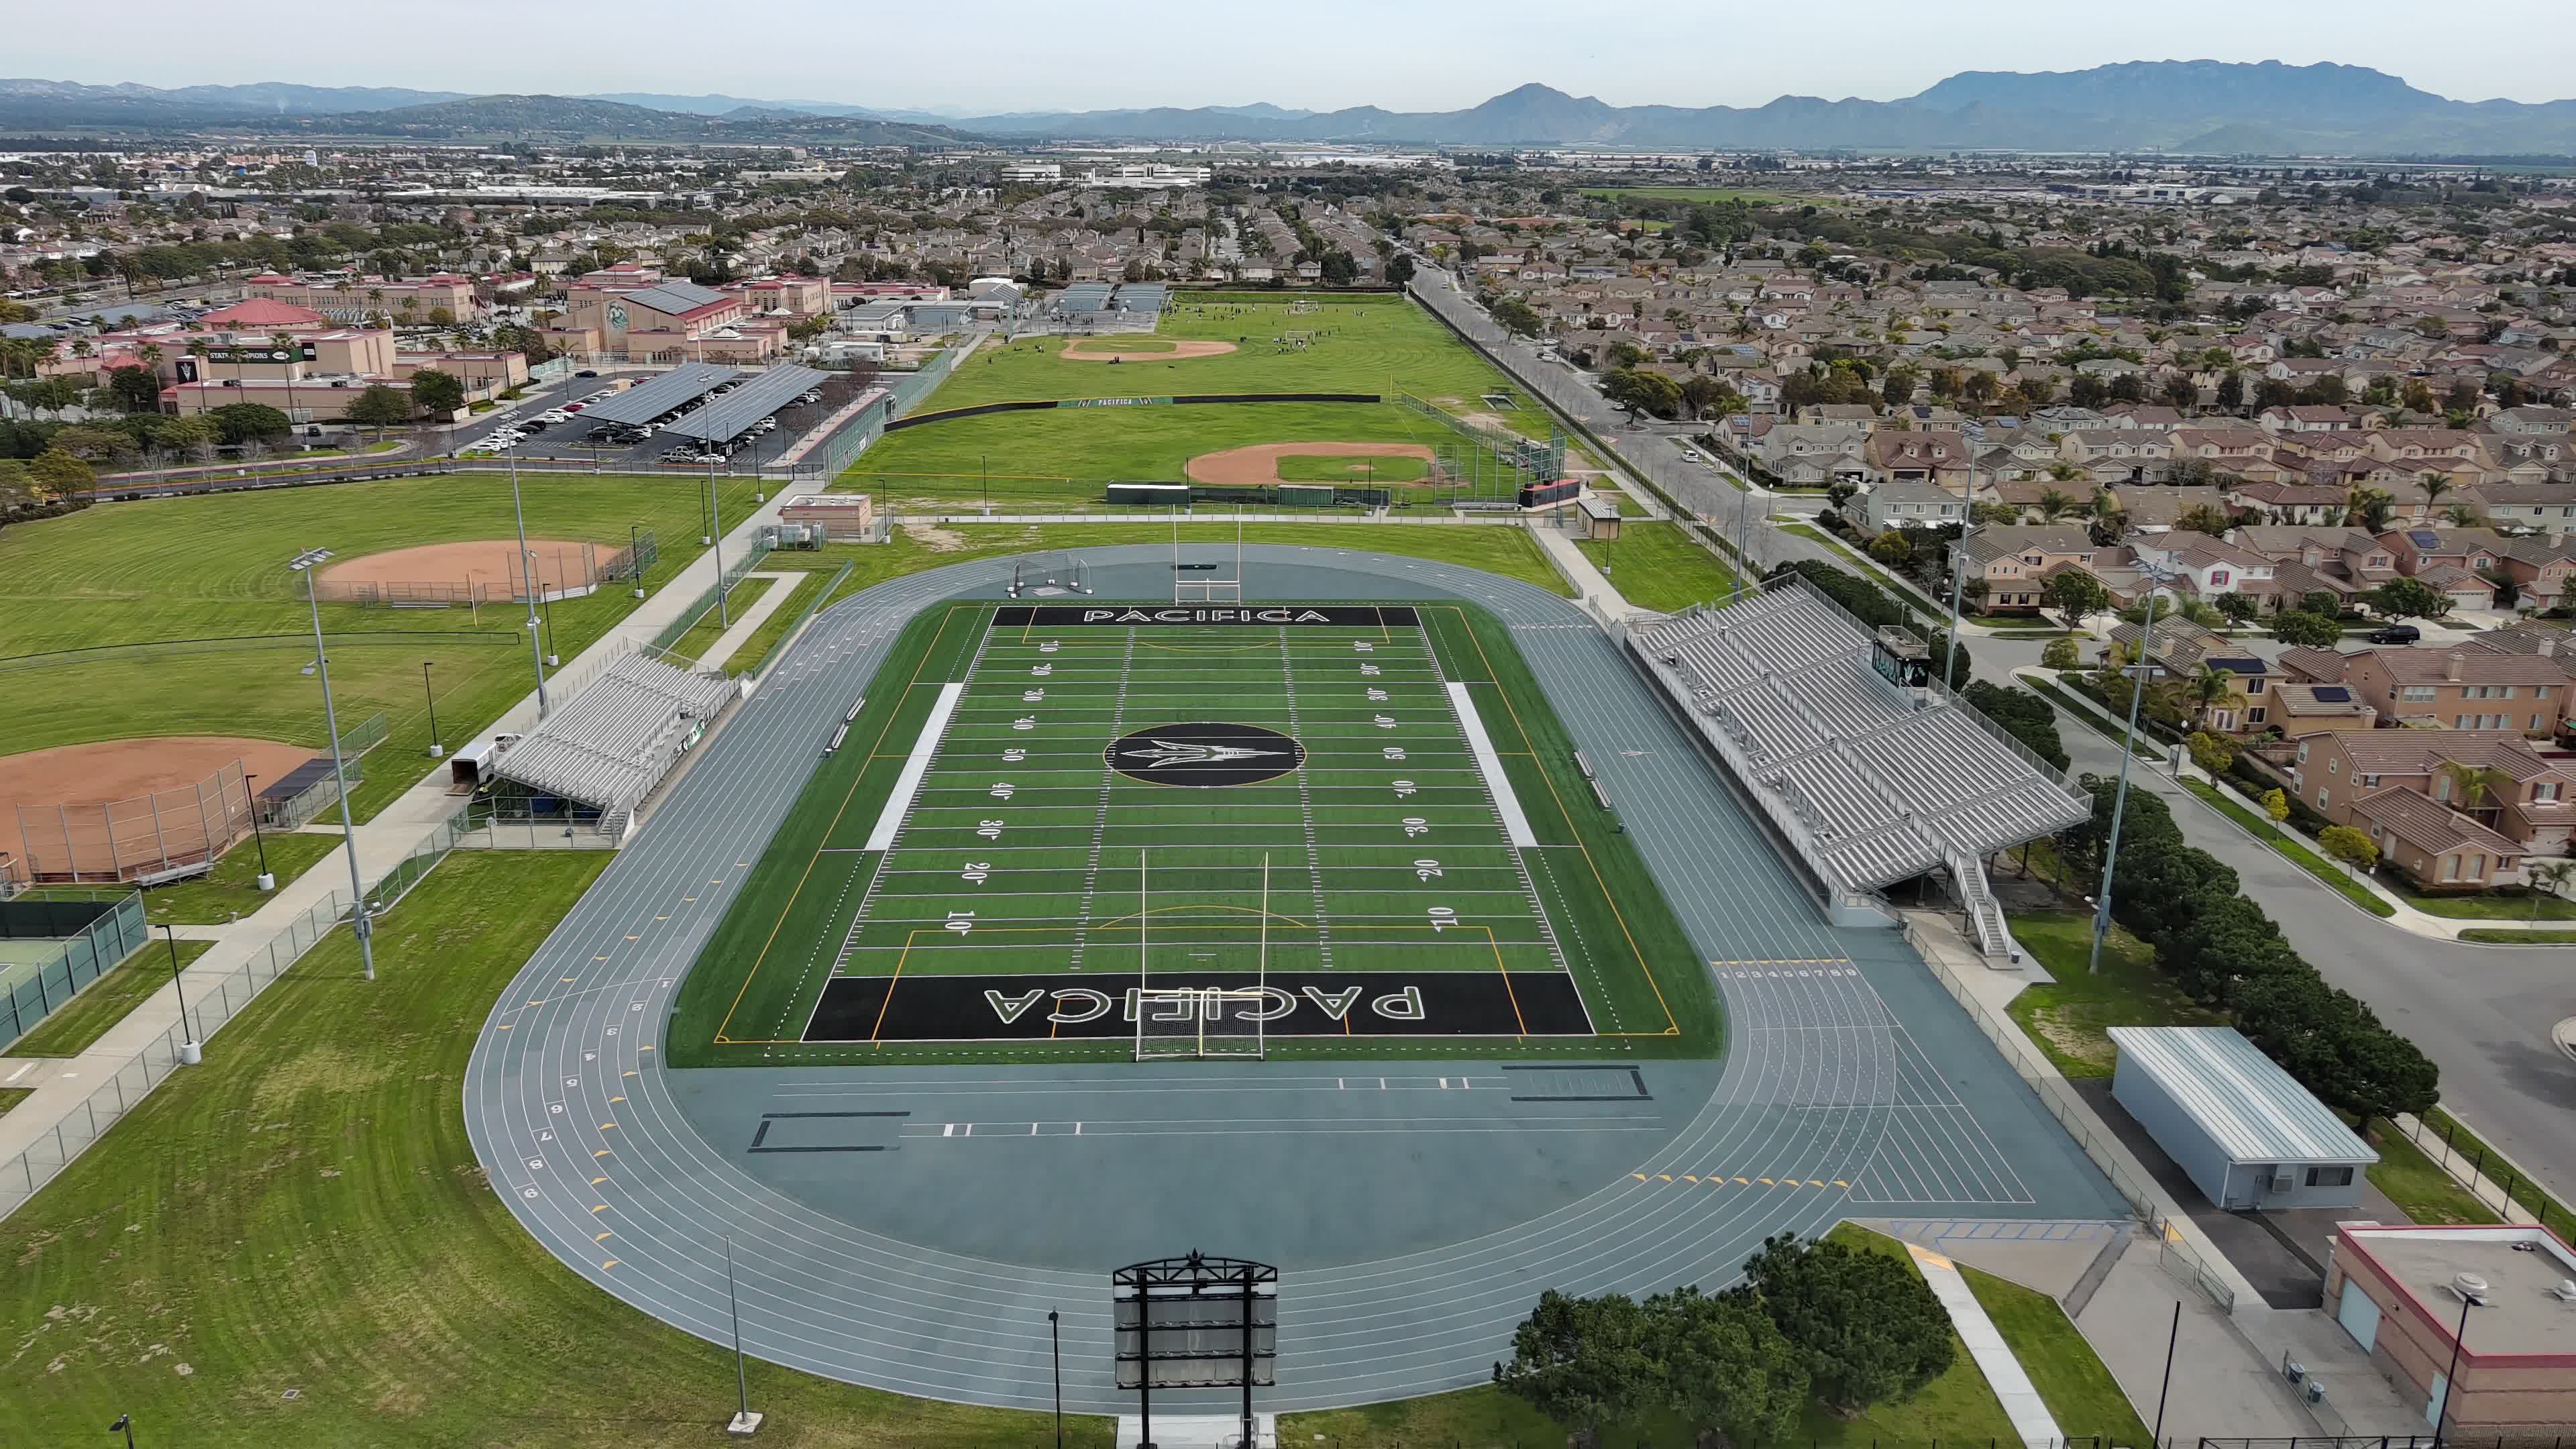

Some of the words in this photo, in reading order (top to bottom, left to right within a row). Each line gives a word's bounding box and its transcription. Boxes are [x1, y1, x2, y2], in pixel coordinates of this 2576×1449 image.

[1083, 610, 1331, 622] PACIFICA
[1040, 643, 1059, 652] 10
[1354, 643, 1373, 652] 10
[1031, 665, 1052, 676] 20
[1360, 665, 1381, 675] 20
[1022, 690, 1044, 701] 30
[1367, 690, 1388, 700] 30
[1013, 718, 1036, 730] 40
[1374, 717, 1397, 729] 40
[1002, 749, 1026, 761] 50
[1383, 747, 1406, 759] 50
[990, 782, 1015, 796] 40
[1391, 780, 1417, 794] 40
[977, 820, 1004, 835] 30
[1402, 818, 1428, 833] 30
[961, 863, 991, 879] 20
[1414, 859, 1443, 876] 20
[945, 910, 975, 930] 10
[1428, 907, 1459, 926] 10
[984, 986, 1426, 1024] PACIFICA
[566, 1079, 578, 1087] 5
[551, 1105, 563, 1114] 6
[541, 1132, 553, 1141] 7
[529, 1159, 543, 1169] 8
[524, 1188, 538, 1198] 9
